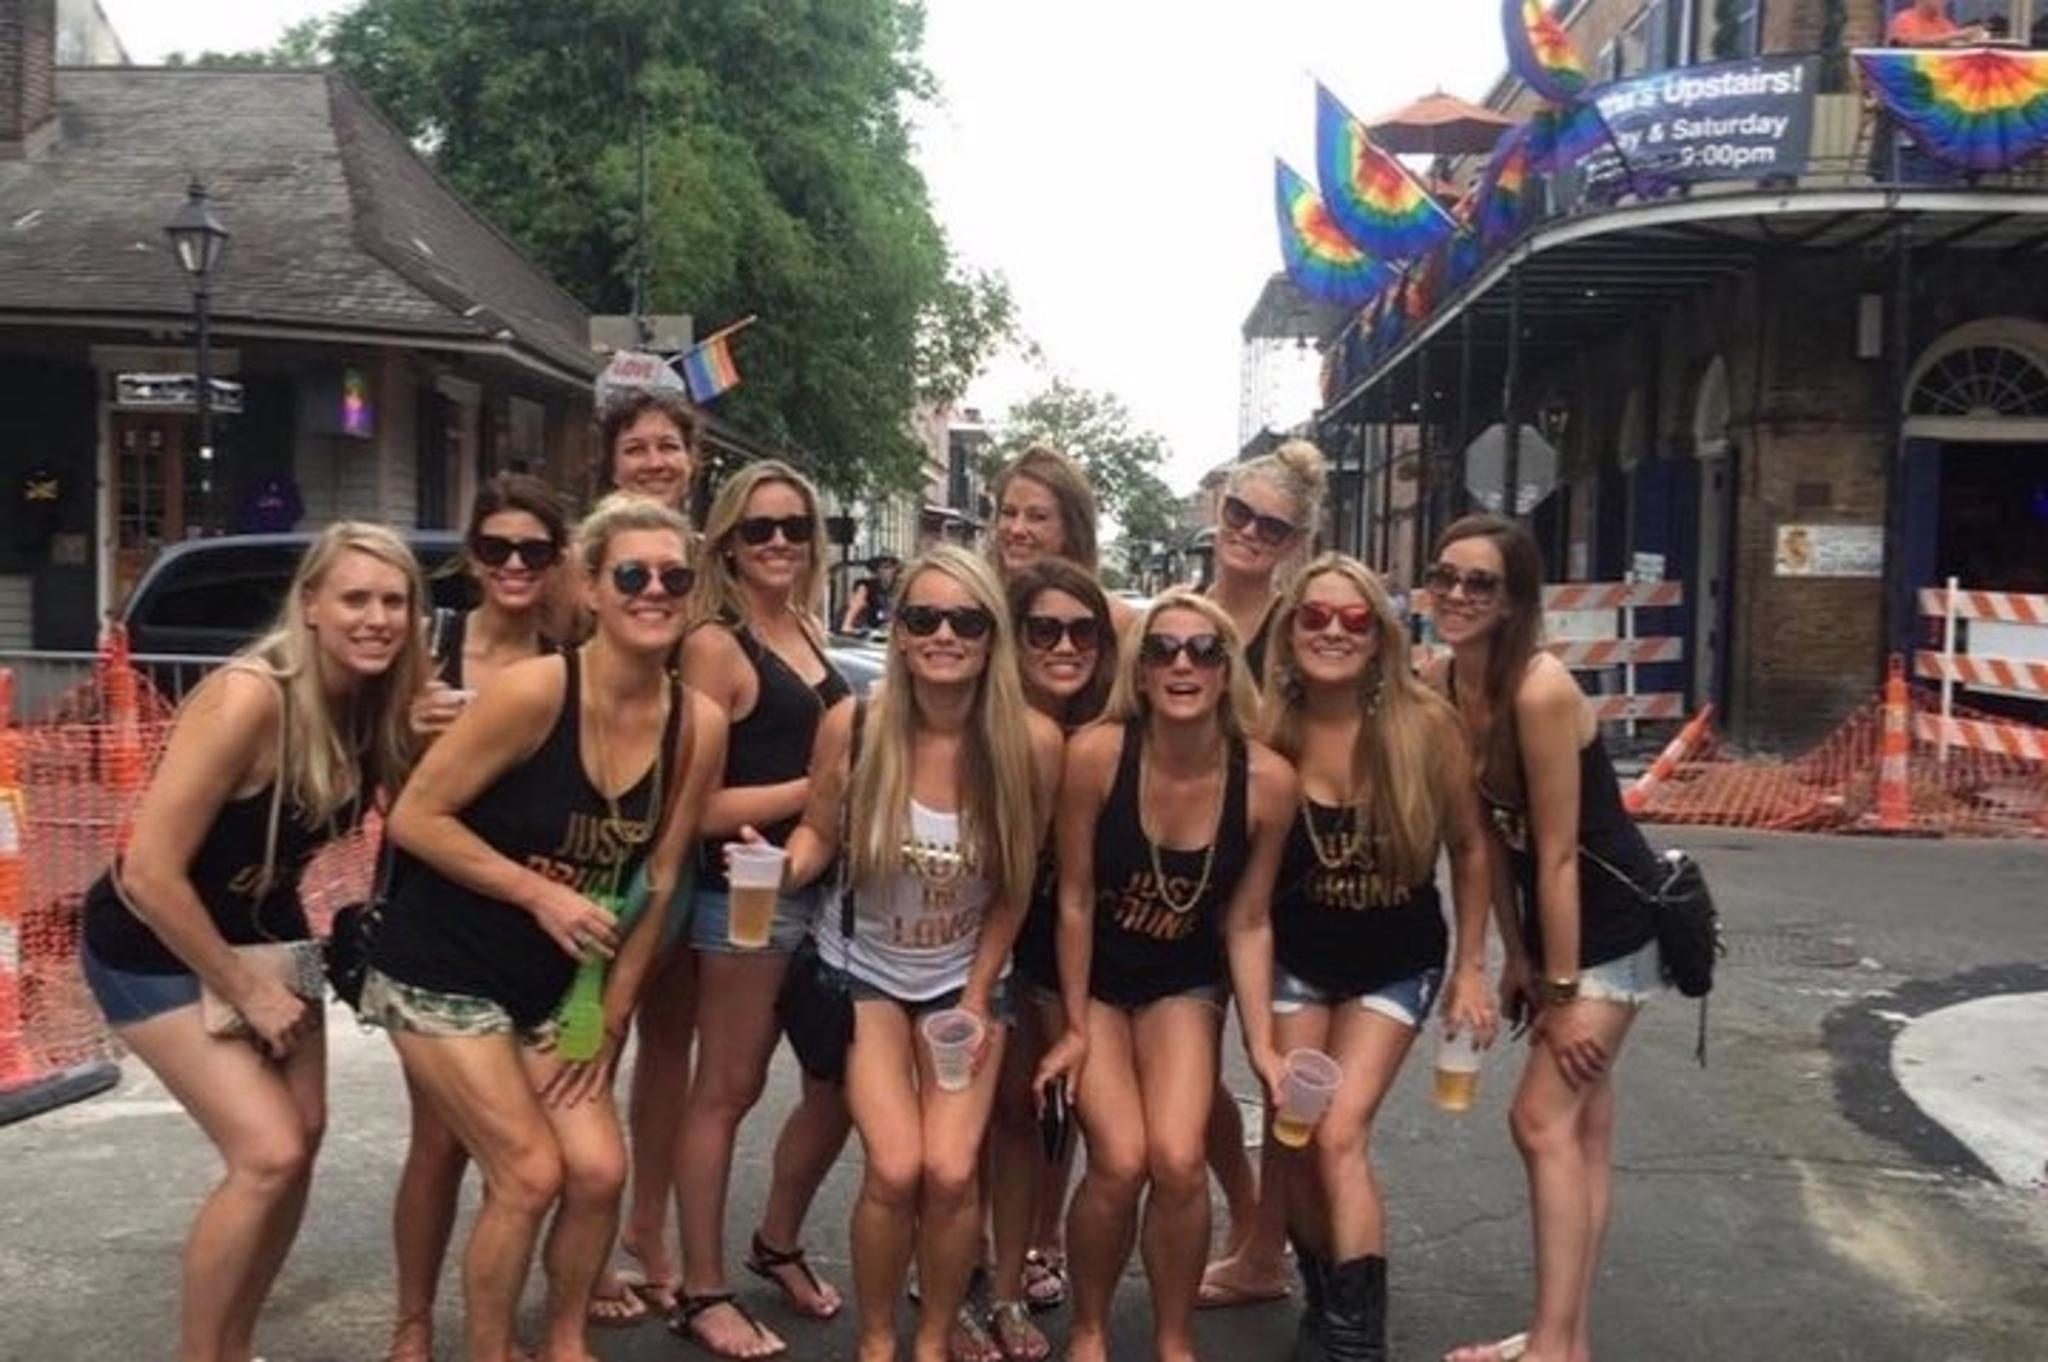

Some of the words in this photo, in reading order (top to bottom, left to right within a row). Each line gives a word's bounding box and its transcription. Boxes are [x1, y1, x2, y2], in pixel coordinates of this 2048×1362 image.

[1663, 64, 1803, 107] Upstairs!
[1648, 121, 1664, 143] &
[1671, 113, 1789, 139] Saturday
[1680, 144, 1776, 169] 9:00pm
